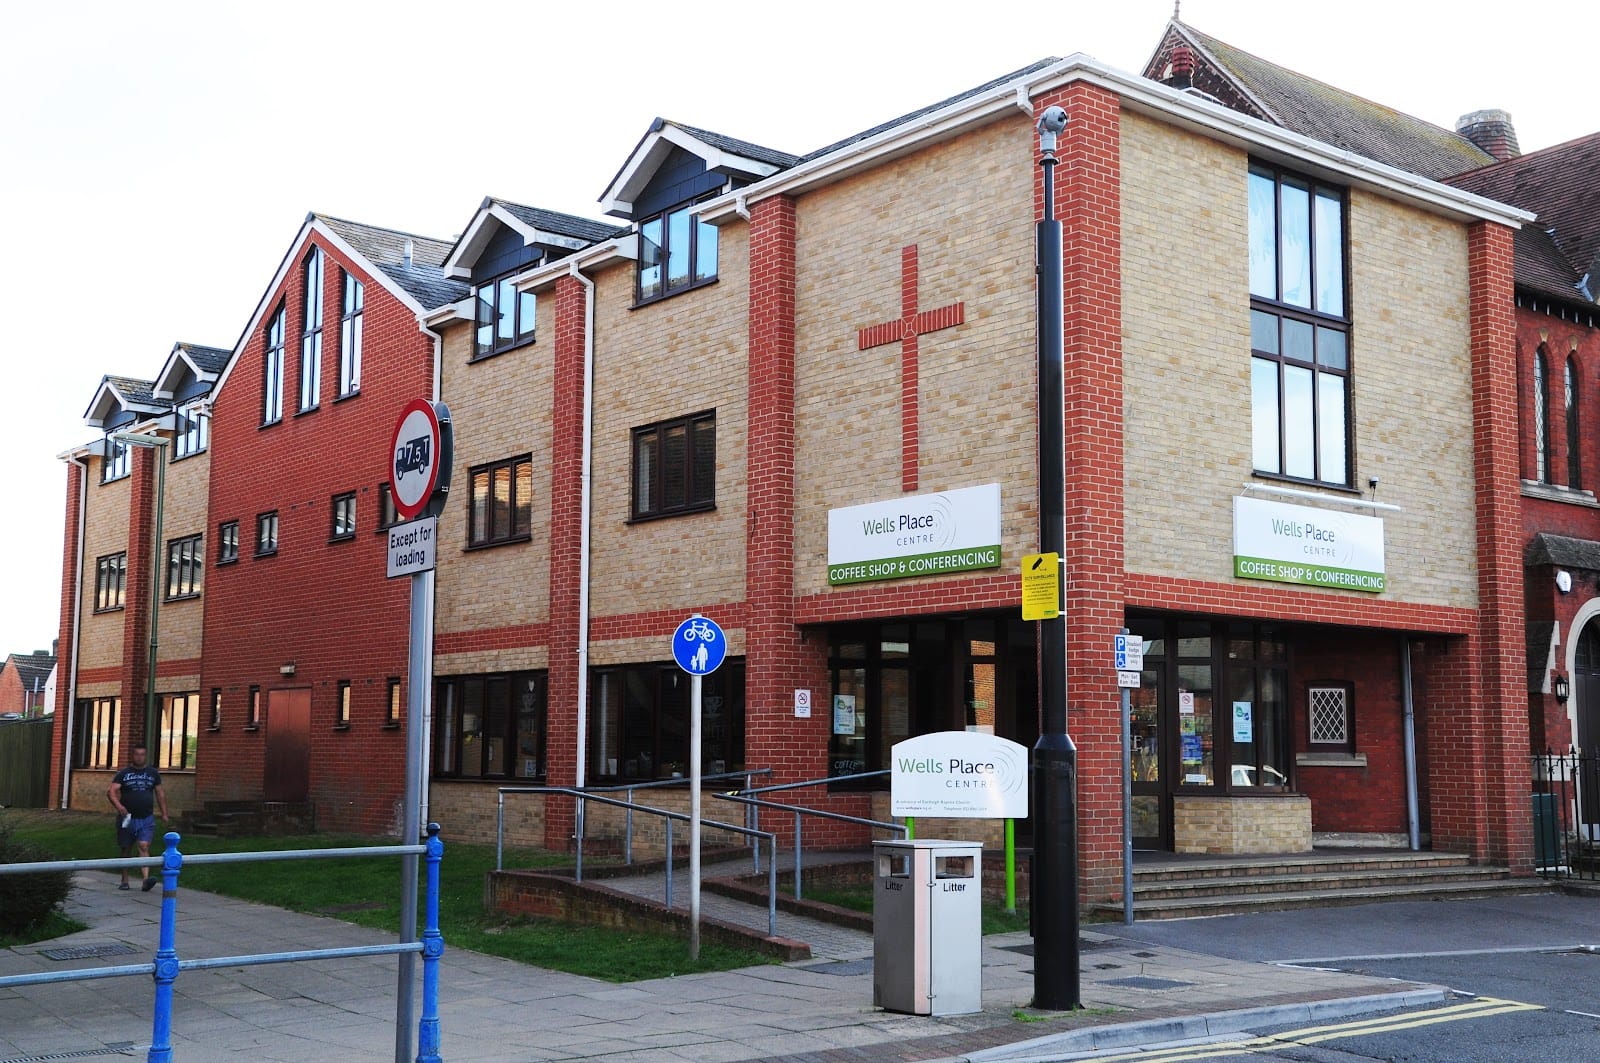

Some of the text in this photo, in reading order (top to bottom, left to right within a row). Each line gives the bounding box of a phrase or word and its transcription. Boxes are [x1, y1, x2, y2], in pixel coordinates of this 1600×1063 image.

[863, 514, 933, 536] Wells Place
[1272, 518, 1335, 542] Wells Place
[390, 527, 432, 549] Except for
[896, 534, 934, 546] CENTRE
[395, 550, 425, 567] loading
[1304, 546, 1336, 557] CENTRE
[830, 550, 995, 580] COFFEE SHOP & CONFERENCING
[1240, 561, 1384, 589] COFFEE SHOP & CONFERENCING
[1118, 638, 1124, 650] P
[898, 758, 994, 774] Wells Place
[946, 780, 992, 788] CENTR
[885, 880, 903, 891] Litter
[943, 883, 966, 892] Litter
